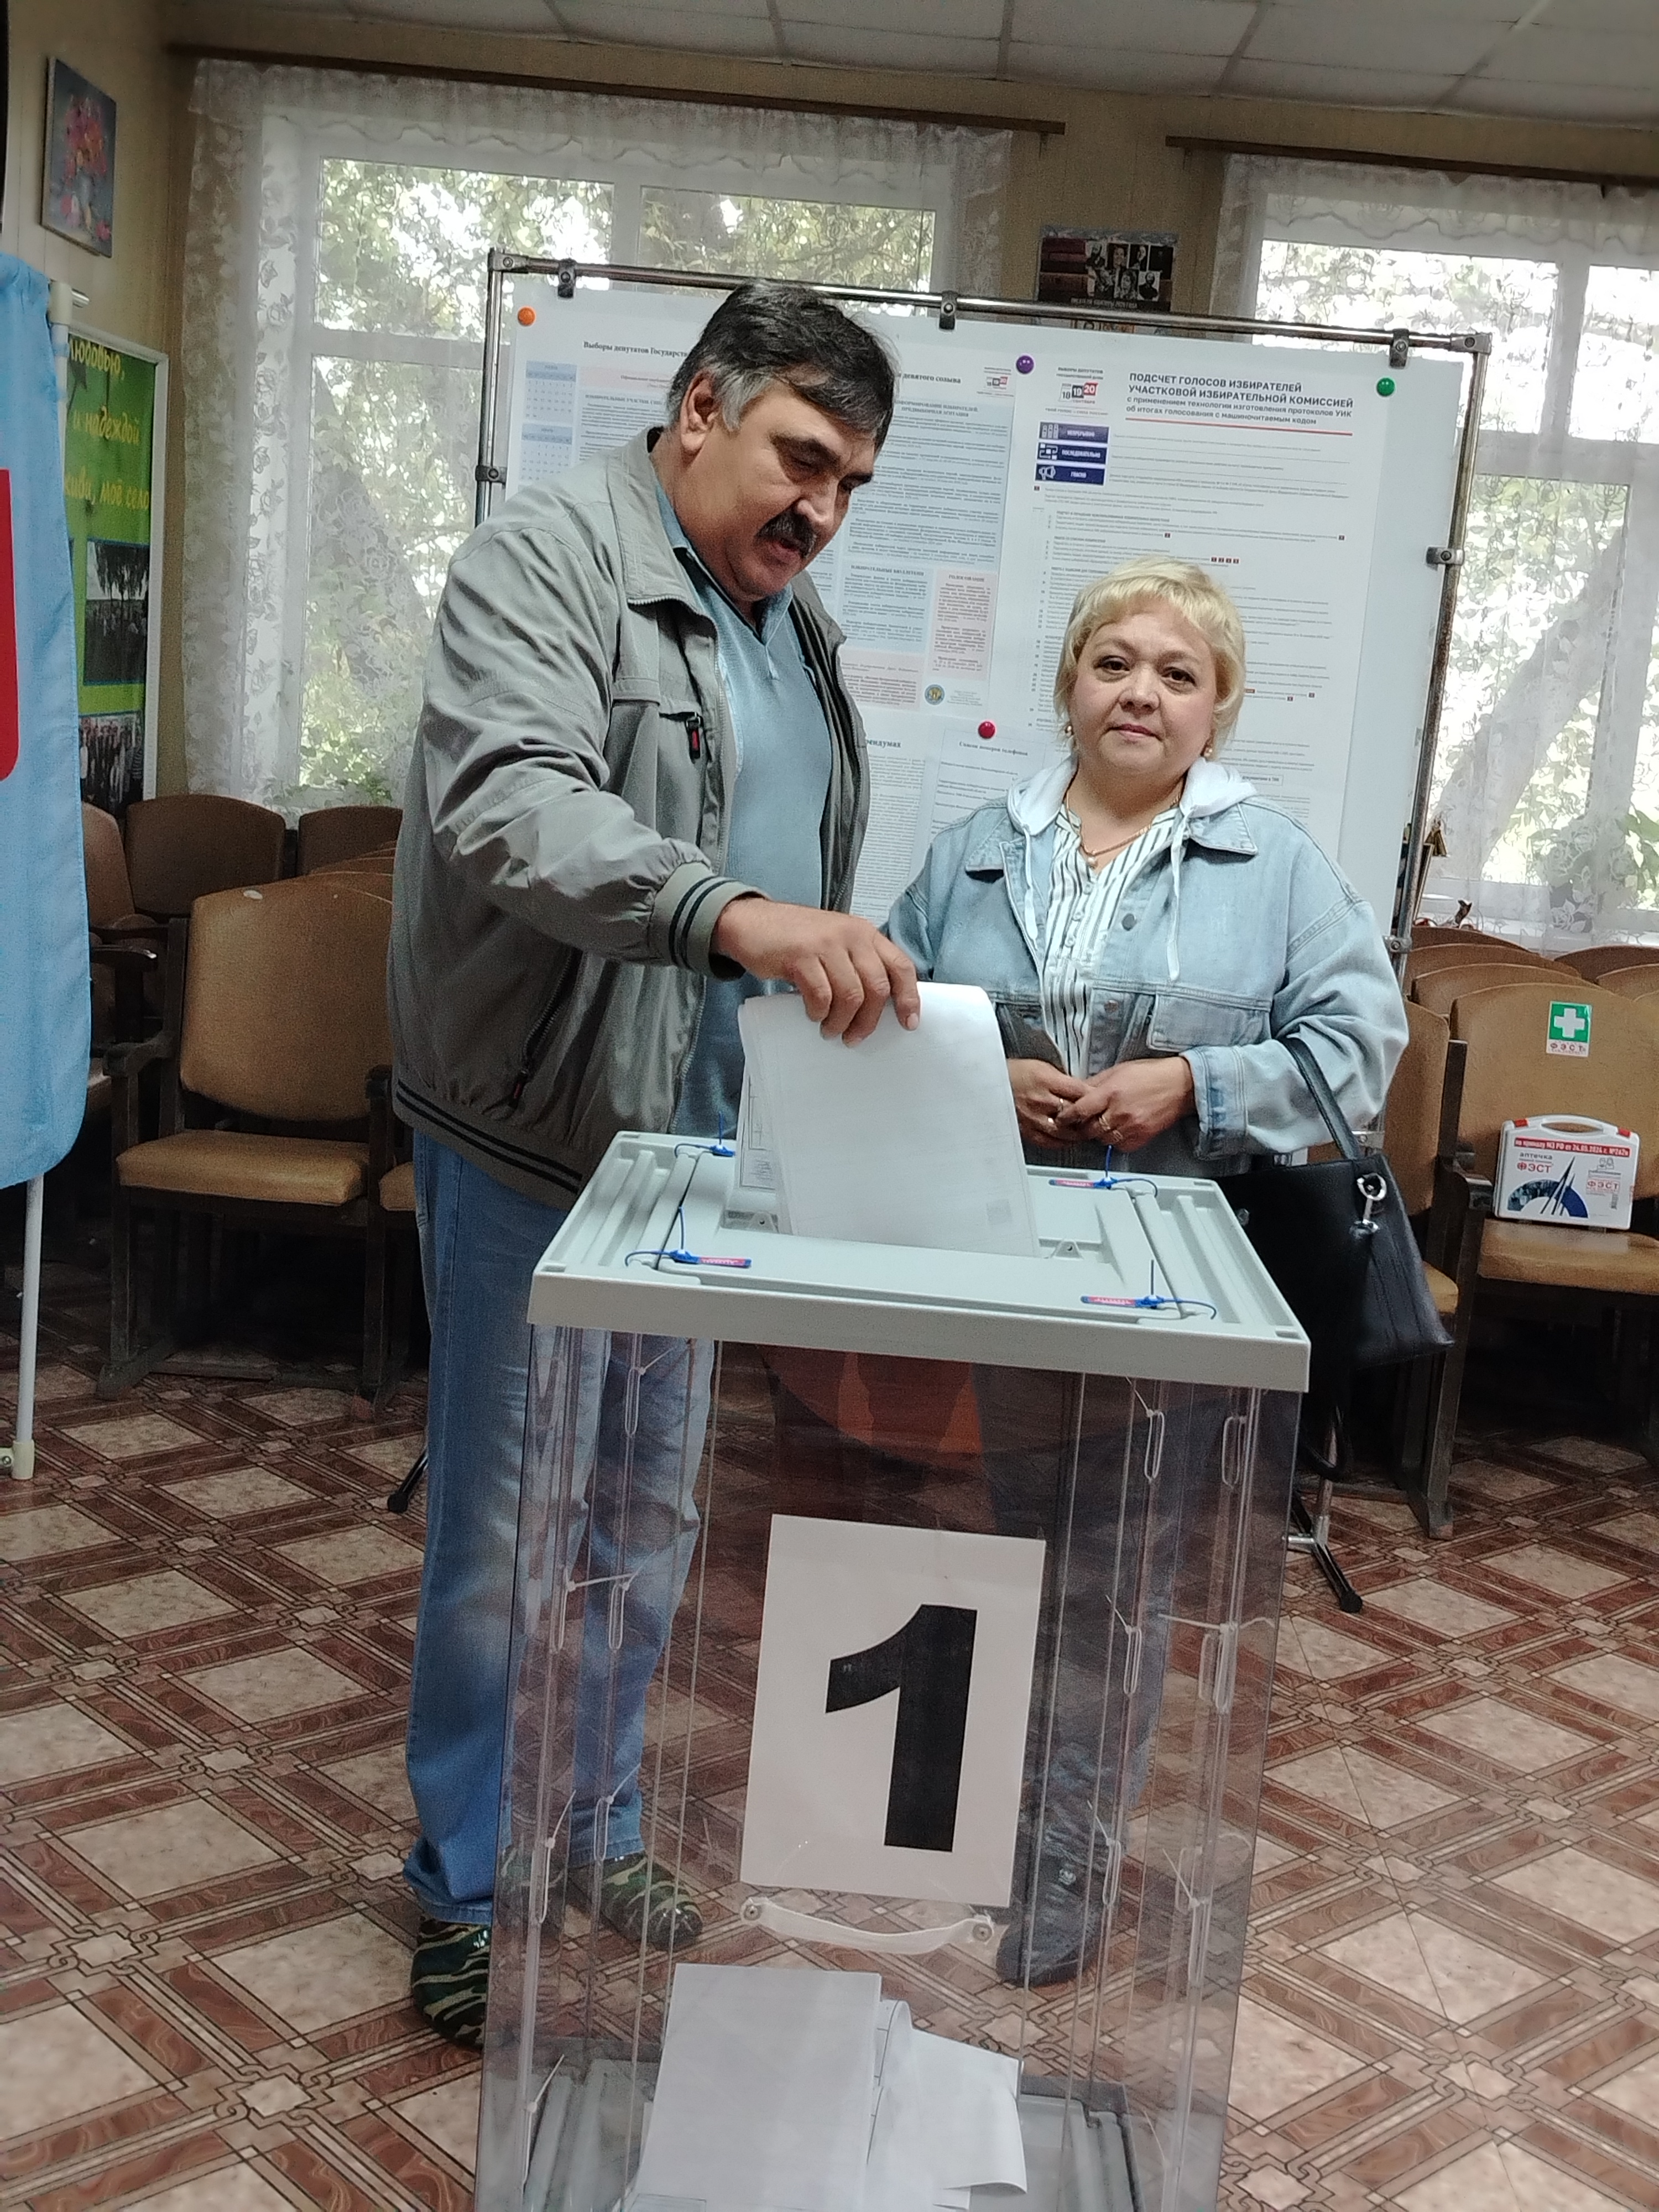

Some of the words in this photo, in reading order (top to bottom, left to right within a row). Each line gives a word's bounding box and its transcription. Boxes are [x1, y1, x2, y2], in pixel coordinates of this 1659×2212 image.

[584, 341, 612, 351] Выборы
[1130, 373, 1176, 383] ПОДСЧЕТ
[1179, 377, 1226, 386] ГОЛОСОВ
[1229, 380, 1301, 391] ИЗБИРАТЕЛЕЙ
[1084, 385, 1095, 394] 20
[1129, 385, 1196, 397] УЧАСТКОВОЙ
[1199, 390, 1286, 401] ИЗБИРАТЕЛЬНОЙ
[1290, 397, 1353, 408] КОМИССИЕЙ
[1517, 1162, 1553, 1173] ФЭСТ
[1587, 1181, 1619, 1190] ФЭСТ
[825, 1604, 977, 1853] 1
